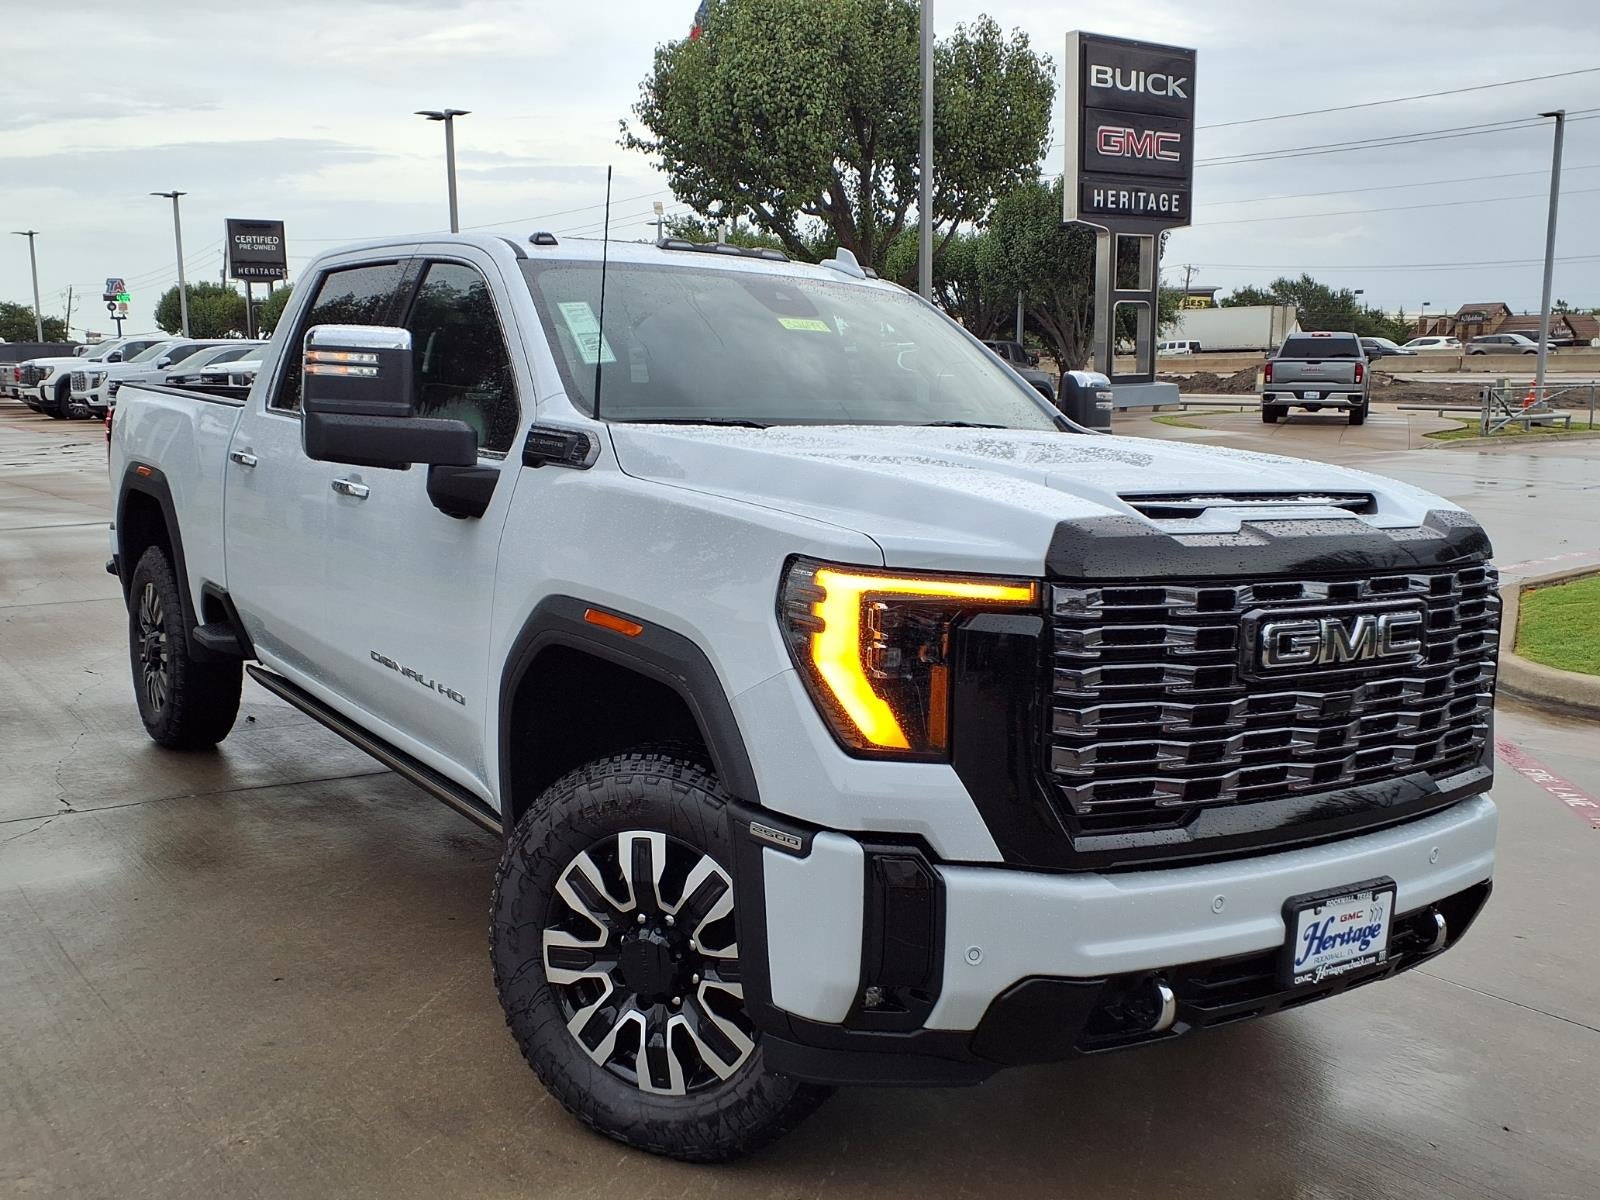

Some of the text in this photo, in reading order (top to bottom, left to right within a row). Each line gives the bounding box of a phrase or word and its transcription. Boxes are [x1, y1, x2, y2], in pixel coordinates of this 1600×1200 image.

[1090, 64, 1188, 99] BUICK
[1096, 125, 1181, 162] GMC
[1093, 189, 1180, 212] HERITAGE
[235, 235, 279, 244] CERTIFIED
[238, 267, 281, 275] HERITAGE
[106, 278, 126, 293] TA
[1262, 612, 1422, 668] GMC
[370, 650, 466, 706] DENALI HD
[752, 826, 799, 846] 2500
[1339, 910, 1364, 923] GMC
[1295, 916, 1382, 966] Heritage
[1294, 973, 1313, 985] GMC
